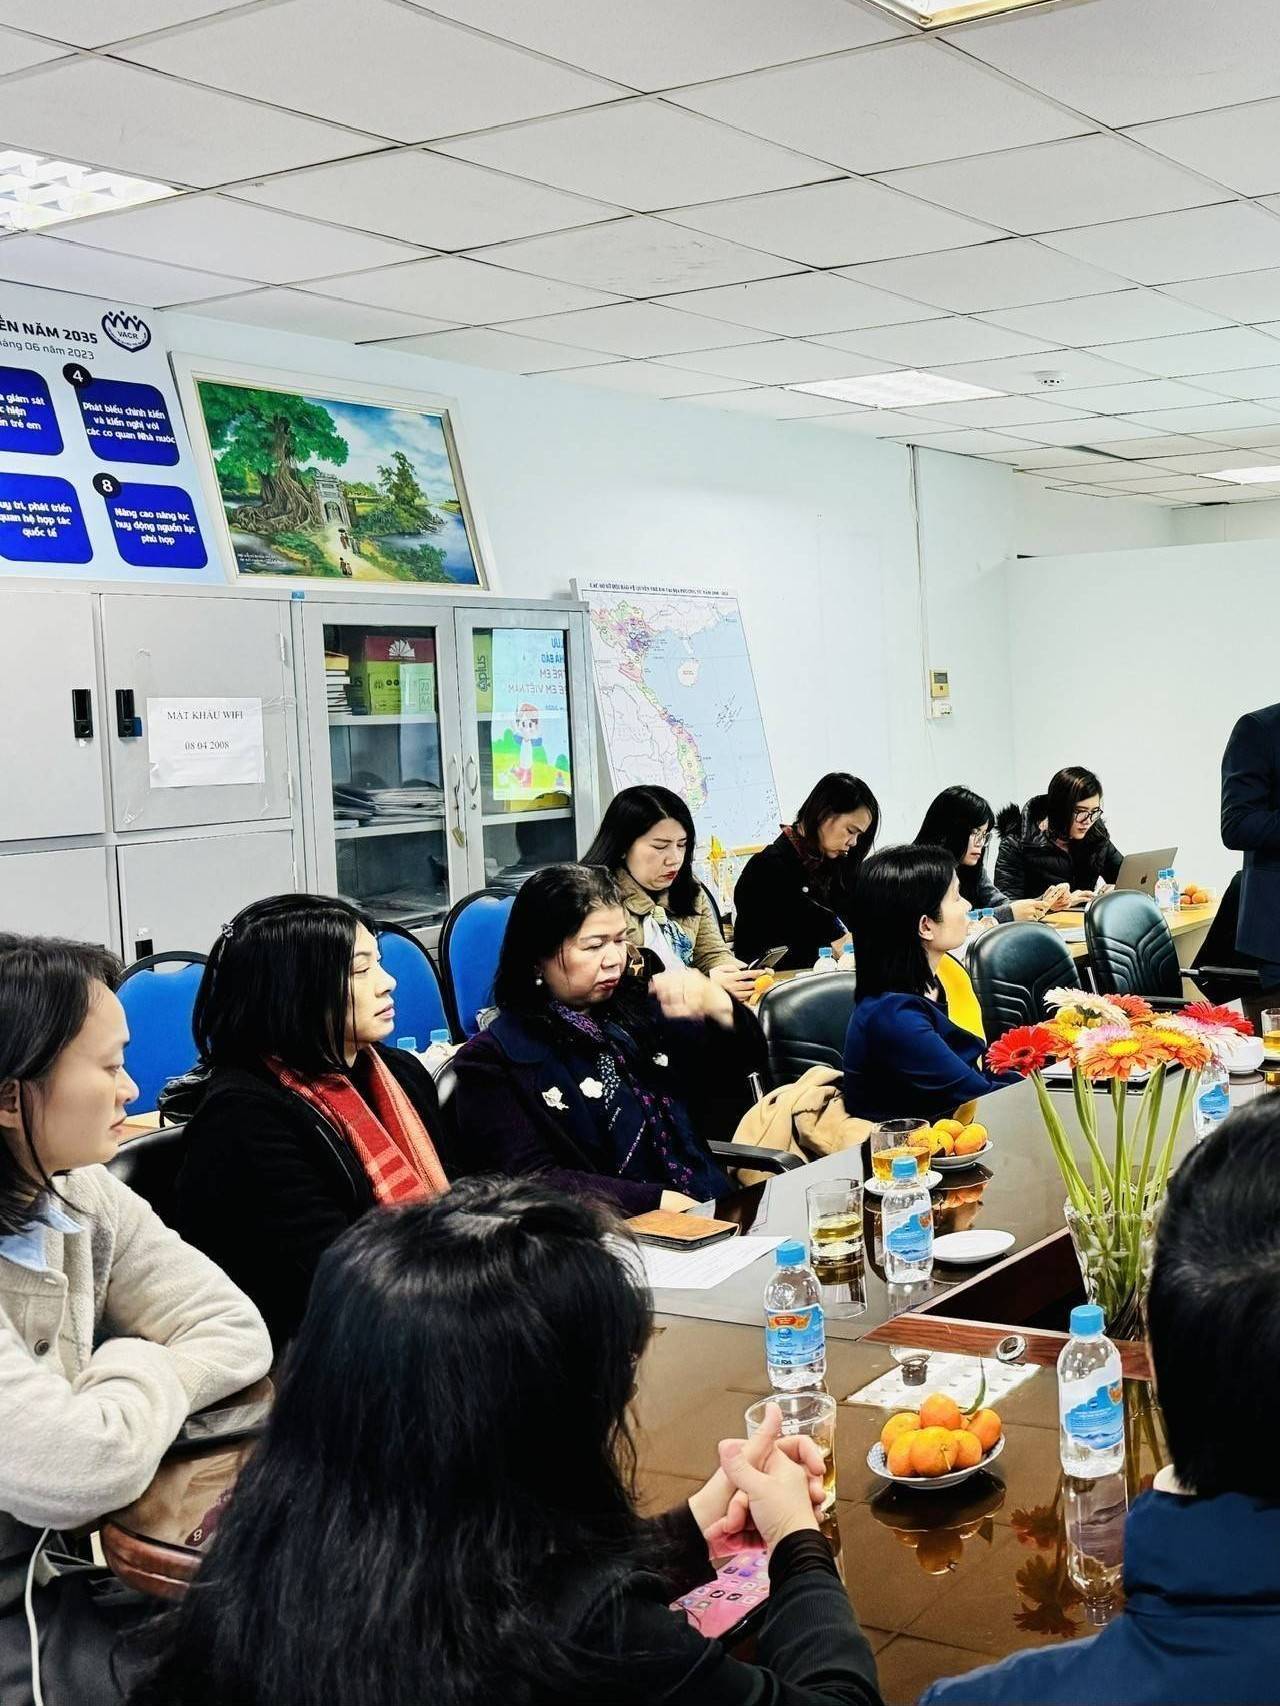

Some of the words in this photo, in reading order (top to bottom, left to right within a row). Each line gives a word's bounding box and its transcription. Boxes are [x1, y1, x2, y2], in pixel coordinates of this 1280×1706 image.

[22, 322, 59, 339] NĂM
[62, 329, 98, 344] 2035
[25, 341, 40, 351] 06
[43, 344, 65, 355] năm
[67, 347, 95, 360] 2023
[72, 370, 83, 382] 4
[115, 431, 136, 440] quan
[102, 479, 113, 492] 8
[139, 510, 155, 518] cao
[115, 520, 132, 531] huy
[223, 710, 243, 720] WIFI
